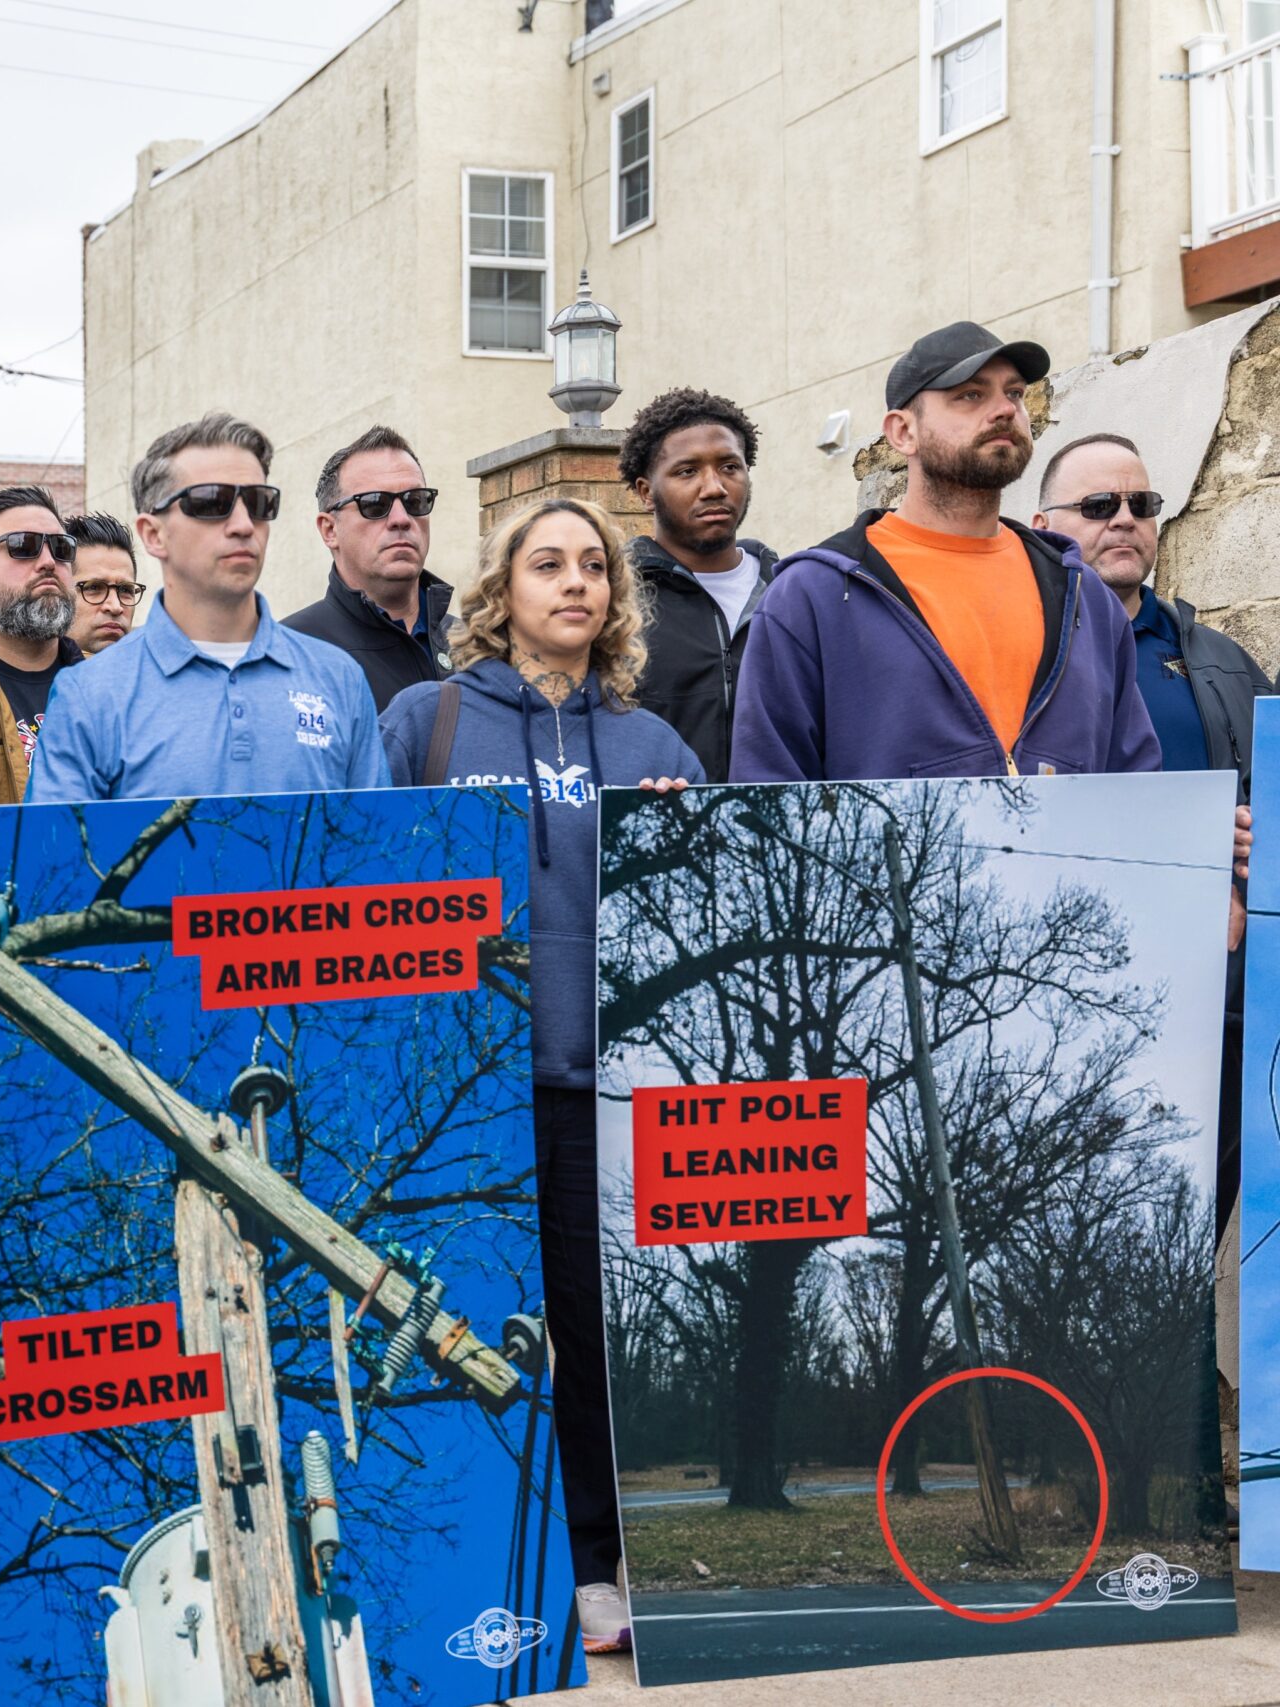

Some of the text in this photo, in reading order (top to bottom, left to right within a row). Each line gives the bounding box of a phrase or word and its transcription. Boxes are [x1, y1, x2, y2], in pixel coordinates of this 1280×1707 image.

[298, 712, 325, 729] 614
[538, 776, 587, 803] 614
[189, 893, 489, 939] BROKEN CROSS
[216, 948, 465, 993] ARM BRACES
[659, 1092, 841, 1127] HIT POLE
[663, 1143, 838, 1179] LEANING
[650, 1194, 852, 1231] SEVERELY
[18, 1319, 162, 1364] TILTED
